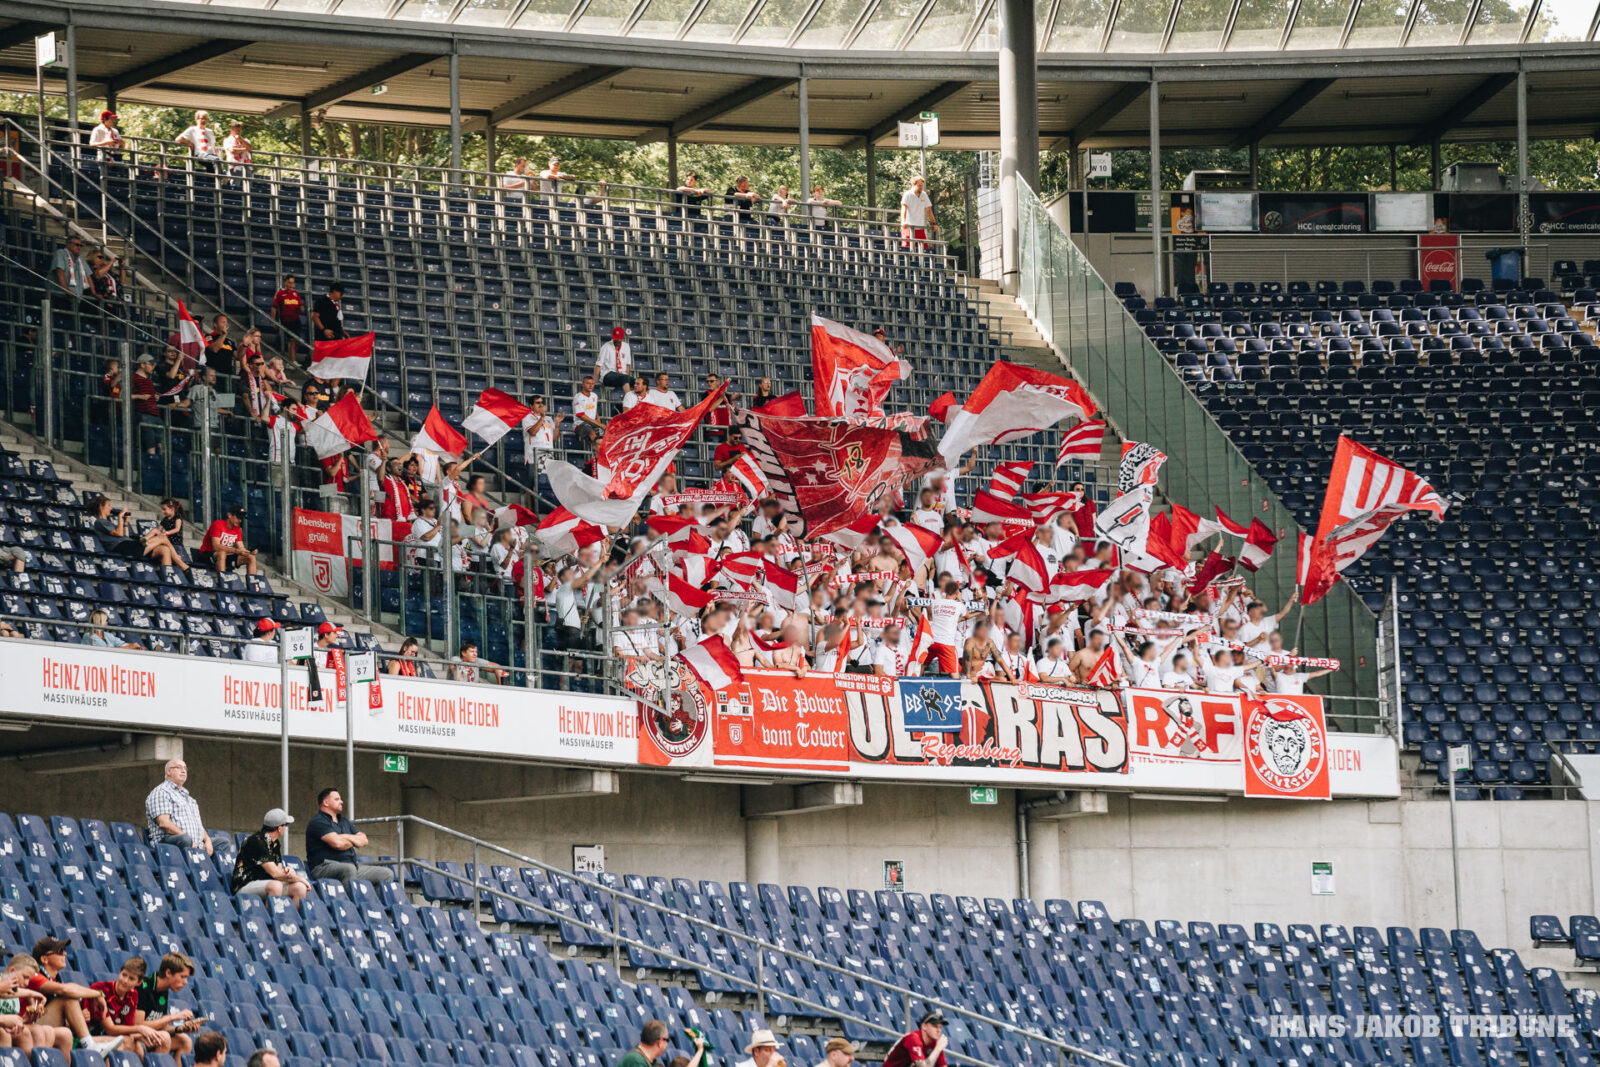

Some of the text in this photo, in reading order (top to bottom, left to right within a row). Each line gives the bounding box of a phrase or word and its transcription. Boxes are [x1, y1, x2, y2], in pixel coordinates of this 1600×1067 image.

[1297, 222, 1313, 230] HCC
[298, 516, 336, 532] Abensberg
[308, 532, 329, 544] grüßt
[293, 643, 304, 651] S 6
[43, 657, 156, 698] HEINZ VON HEIDEN
[356, 667, 367, 675] S 7
[834, 672, 880, 684] CHRISTOPH FÜR
[224, 675, 260, 707] HEINZ
[263, 683, 282, 708] VO
[835, 680, 880, 692] IMMER BEI UNS
[43, 693, 108, 707] MASSIVHÄUSER
[758, 687, 843, 718] Die Power
[904, 694, 923, 713] BB
[224, 709, 281, 722] MASSIVHÄUSE
[398, 691, 499, 728] HEINZ VON HEIDEN
[558, 705, 591, 735] HEINZ
[593, 713, 614, 738] VON
[847, 684, 1128, 773] ULRAS
[398, 724, 456, 737] MASSIVHÄUSER
[761, 722, 846, 749] vom Tower
[559, 737, 614, 750] MASSIVHÄUSER
[921, 735, 1022, 768] Regensburg
